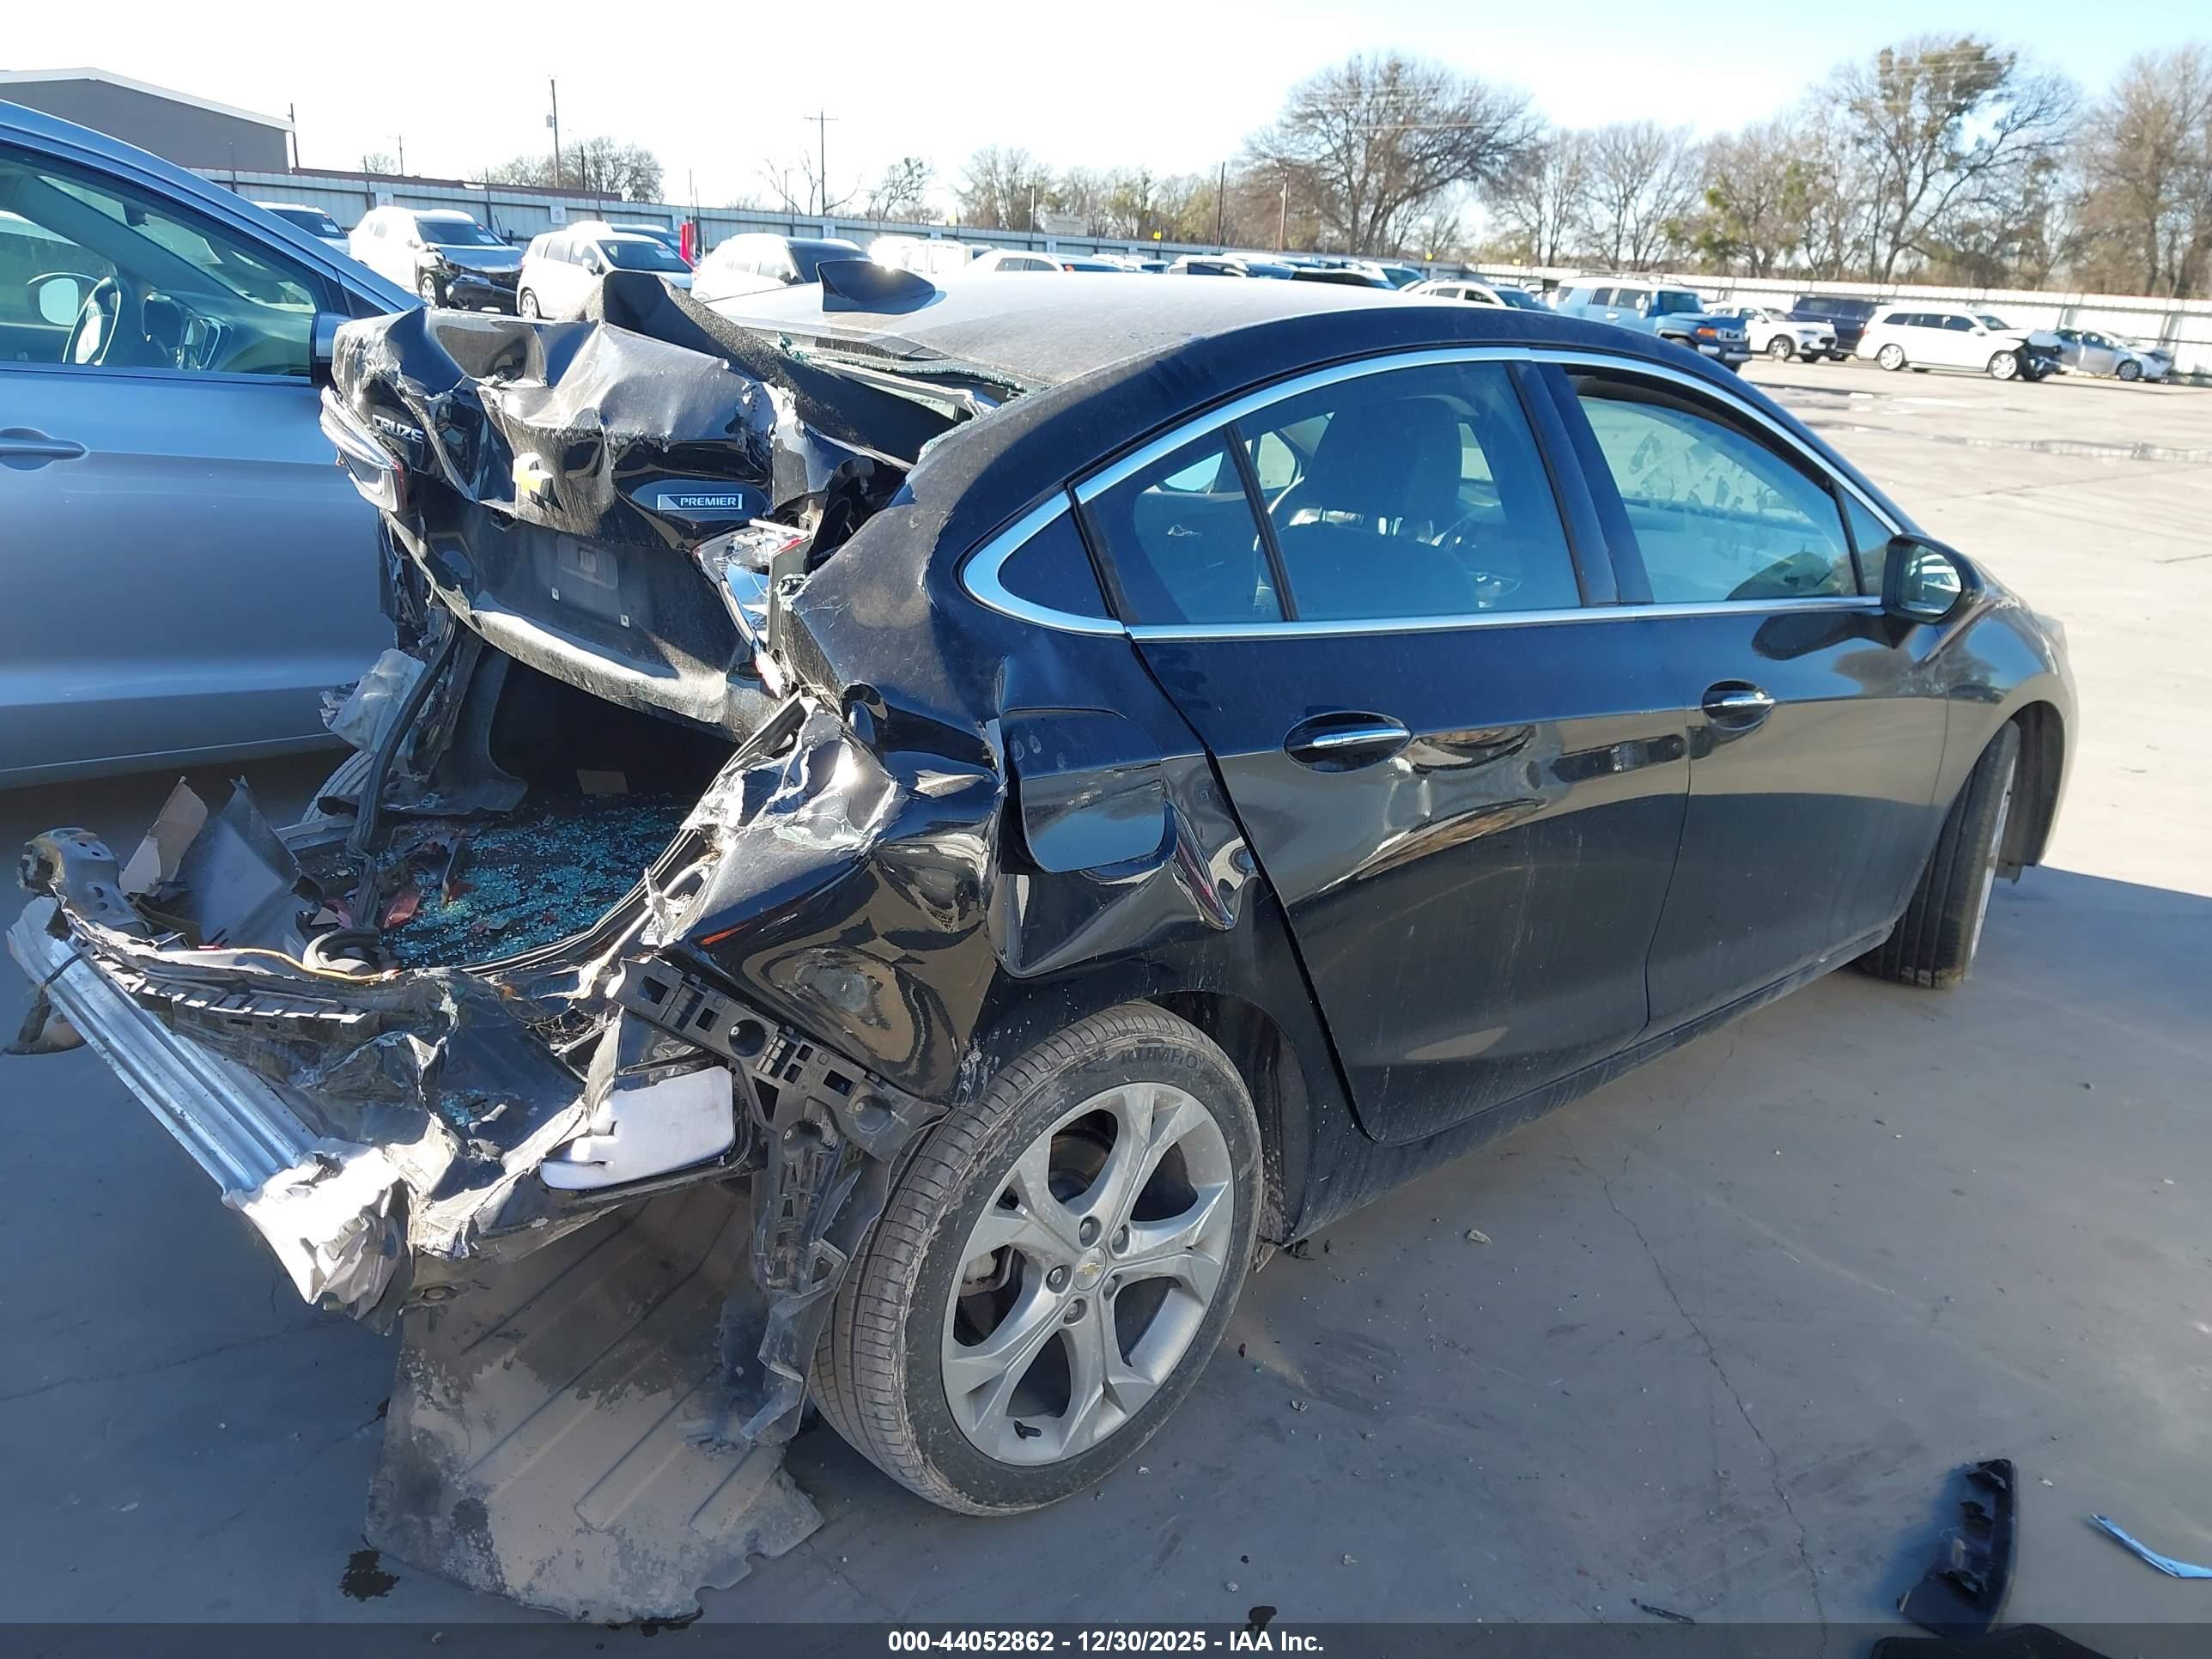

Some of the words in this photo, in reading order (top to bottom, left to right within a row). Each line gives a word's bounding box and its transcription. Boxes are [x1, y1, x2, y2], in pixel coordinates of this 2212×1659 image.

[372, 414, 424, 444] CRUZE
[680, 497, 737, 507] PREMIER
[1121, 1046, 1199, 1068] KUMHO
